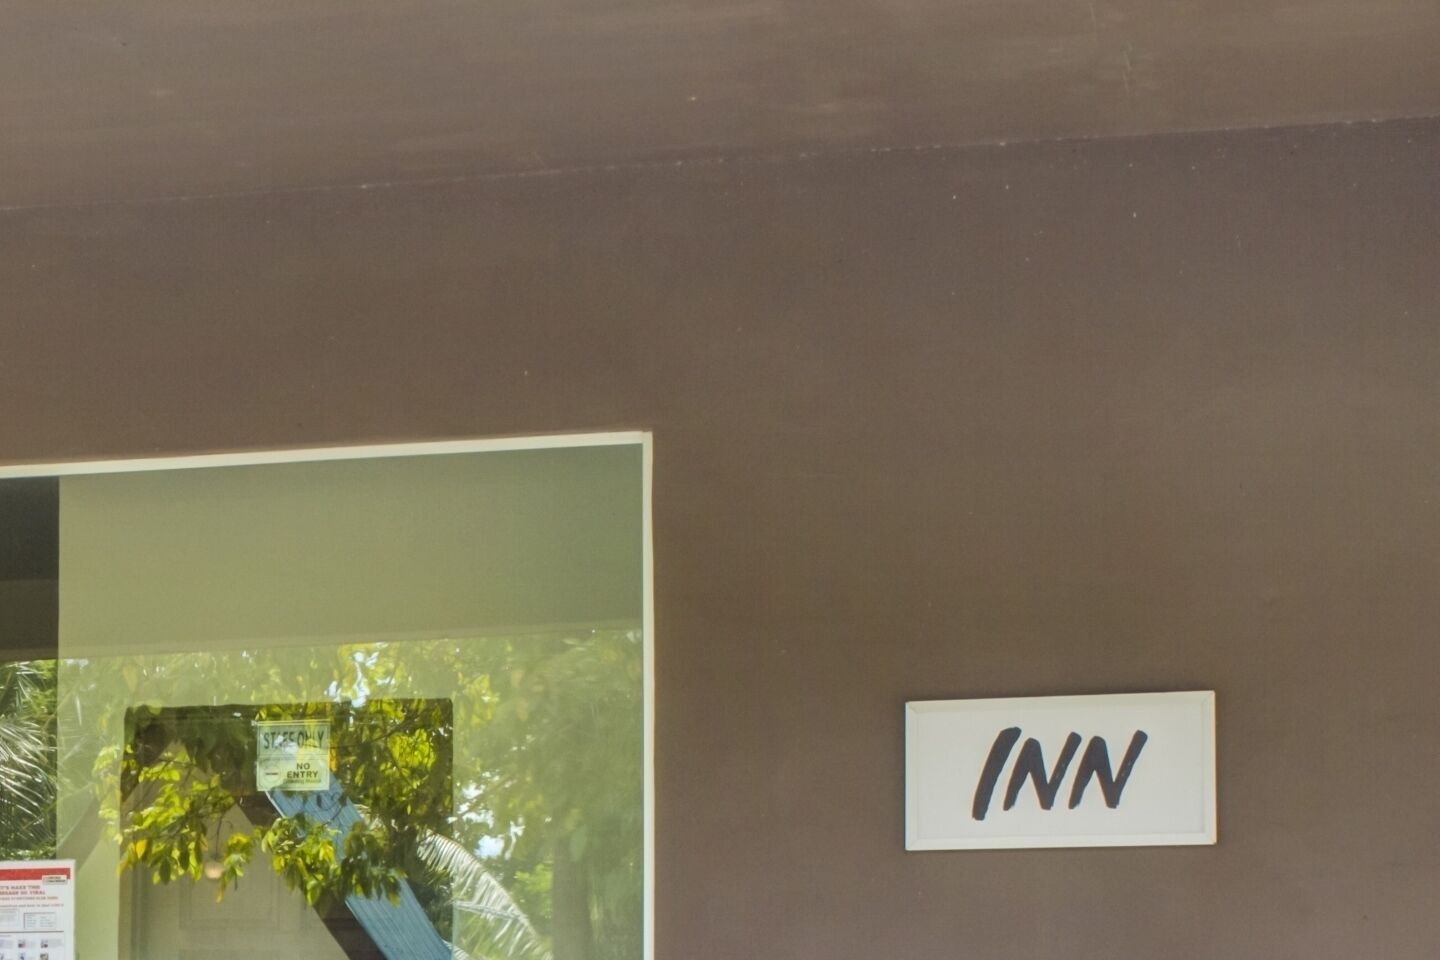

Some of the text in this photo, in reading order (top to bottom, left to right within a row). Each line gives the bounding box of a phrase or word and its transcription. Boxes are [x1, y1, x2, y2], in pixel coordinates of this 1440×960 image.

[296, 762, 311, 770] NO
[286, 770, 319, 779] ENTRY
[971, 726, 1149, 821] INN
